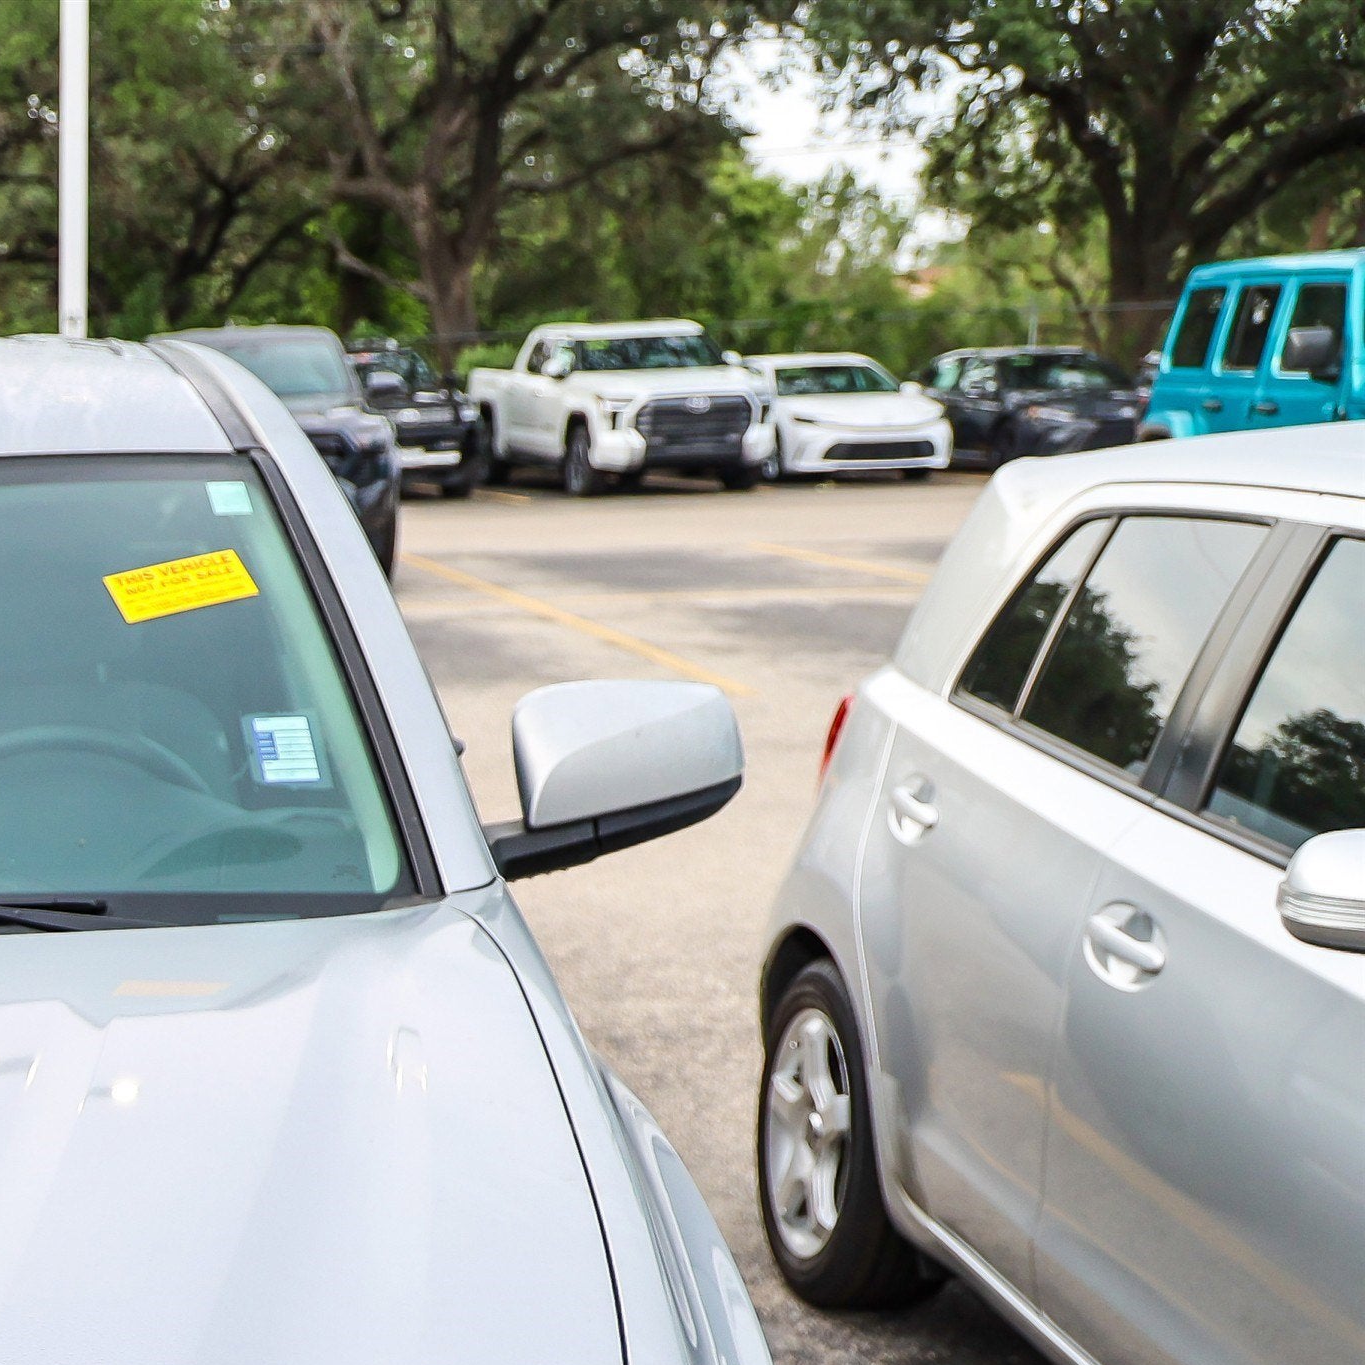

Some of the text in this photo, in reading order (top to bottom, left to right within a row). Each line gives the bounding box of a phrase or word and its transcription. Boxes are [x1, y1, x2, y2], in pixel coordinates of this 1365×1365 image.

[114, 554, 233, 586] THIS VEHICLE
[125, 583, 155, 596] NOT
[161, 575, 191, 588] FOR
[196, 565, 235, 580] SALE
